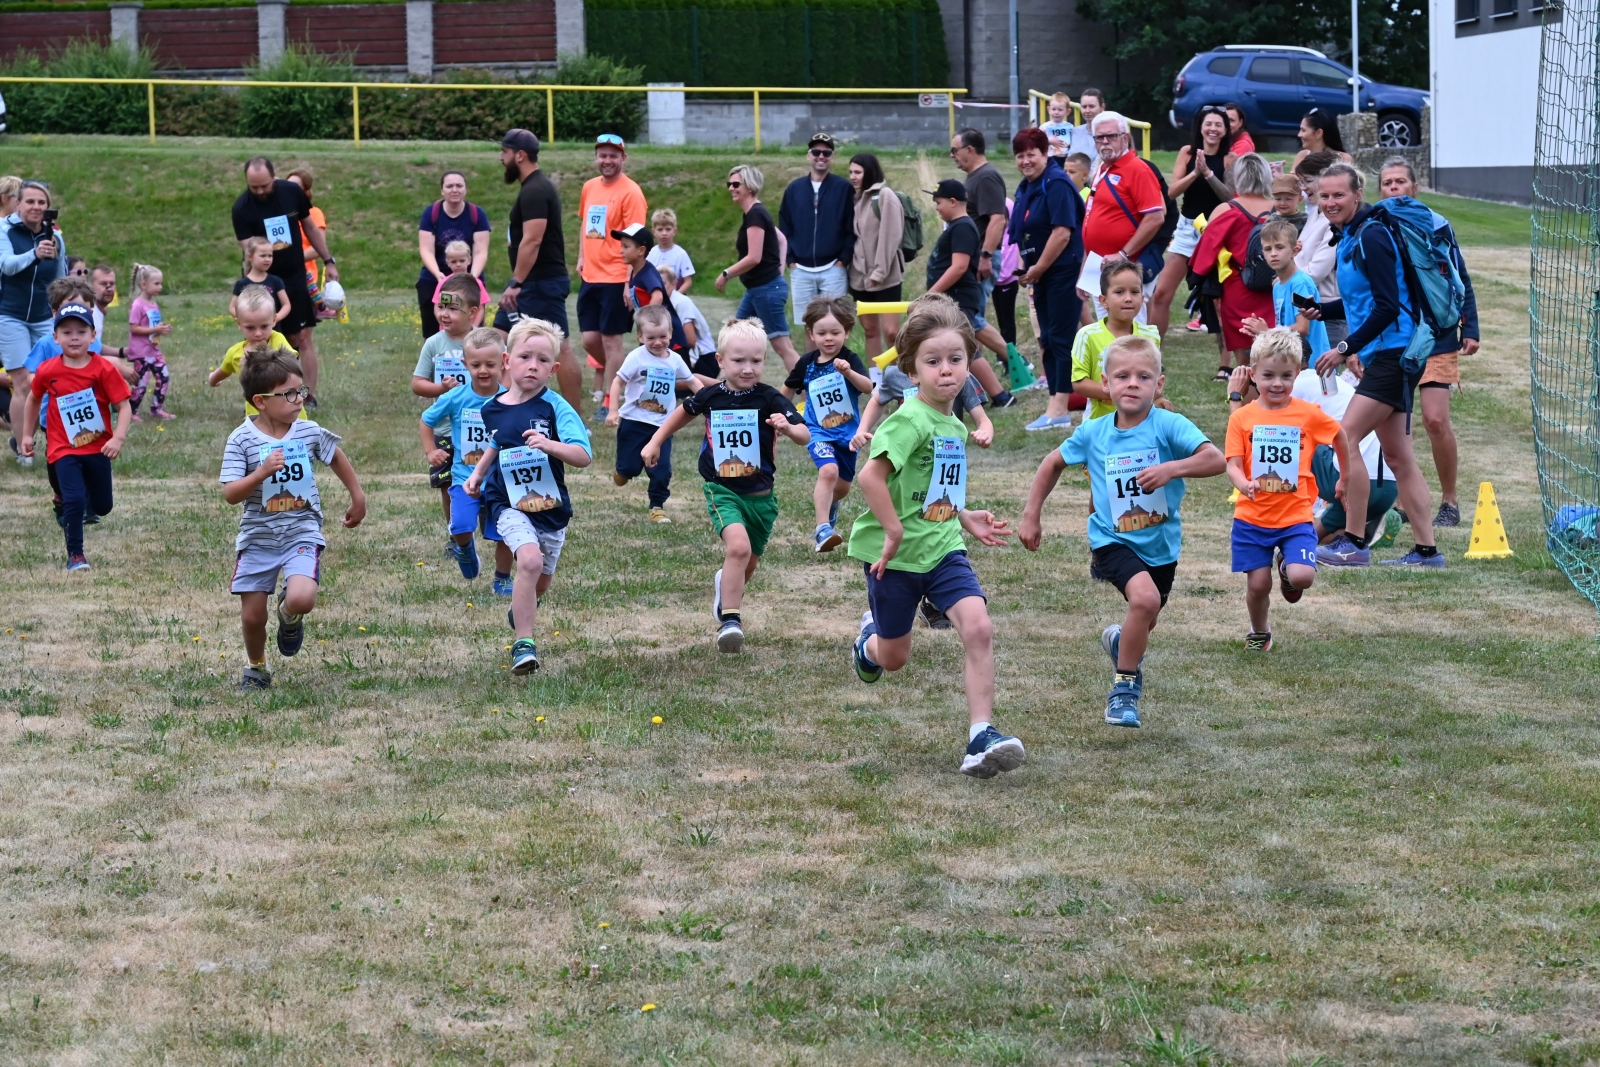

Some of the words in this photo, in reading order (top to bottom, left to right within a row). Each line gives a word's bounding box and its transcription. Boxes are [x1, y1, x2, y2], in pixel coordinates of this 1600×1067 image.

[591, 215, 601, 225] 67
[271, 226, 285, 236] 80
[649, 380, 671, 395] 129
[816, 388, 844, 408] 136
[66, 405, 95, 426] 146
[718, 430, 752, 448] 140
[1259, 445, 1293, 464] 138
[510, 465, 543, 486] 137
[938, 463, 961, 486] 141
[1300, 548, 1316, 563] 10
